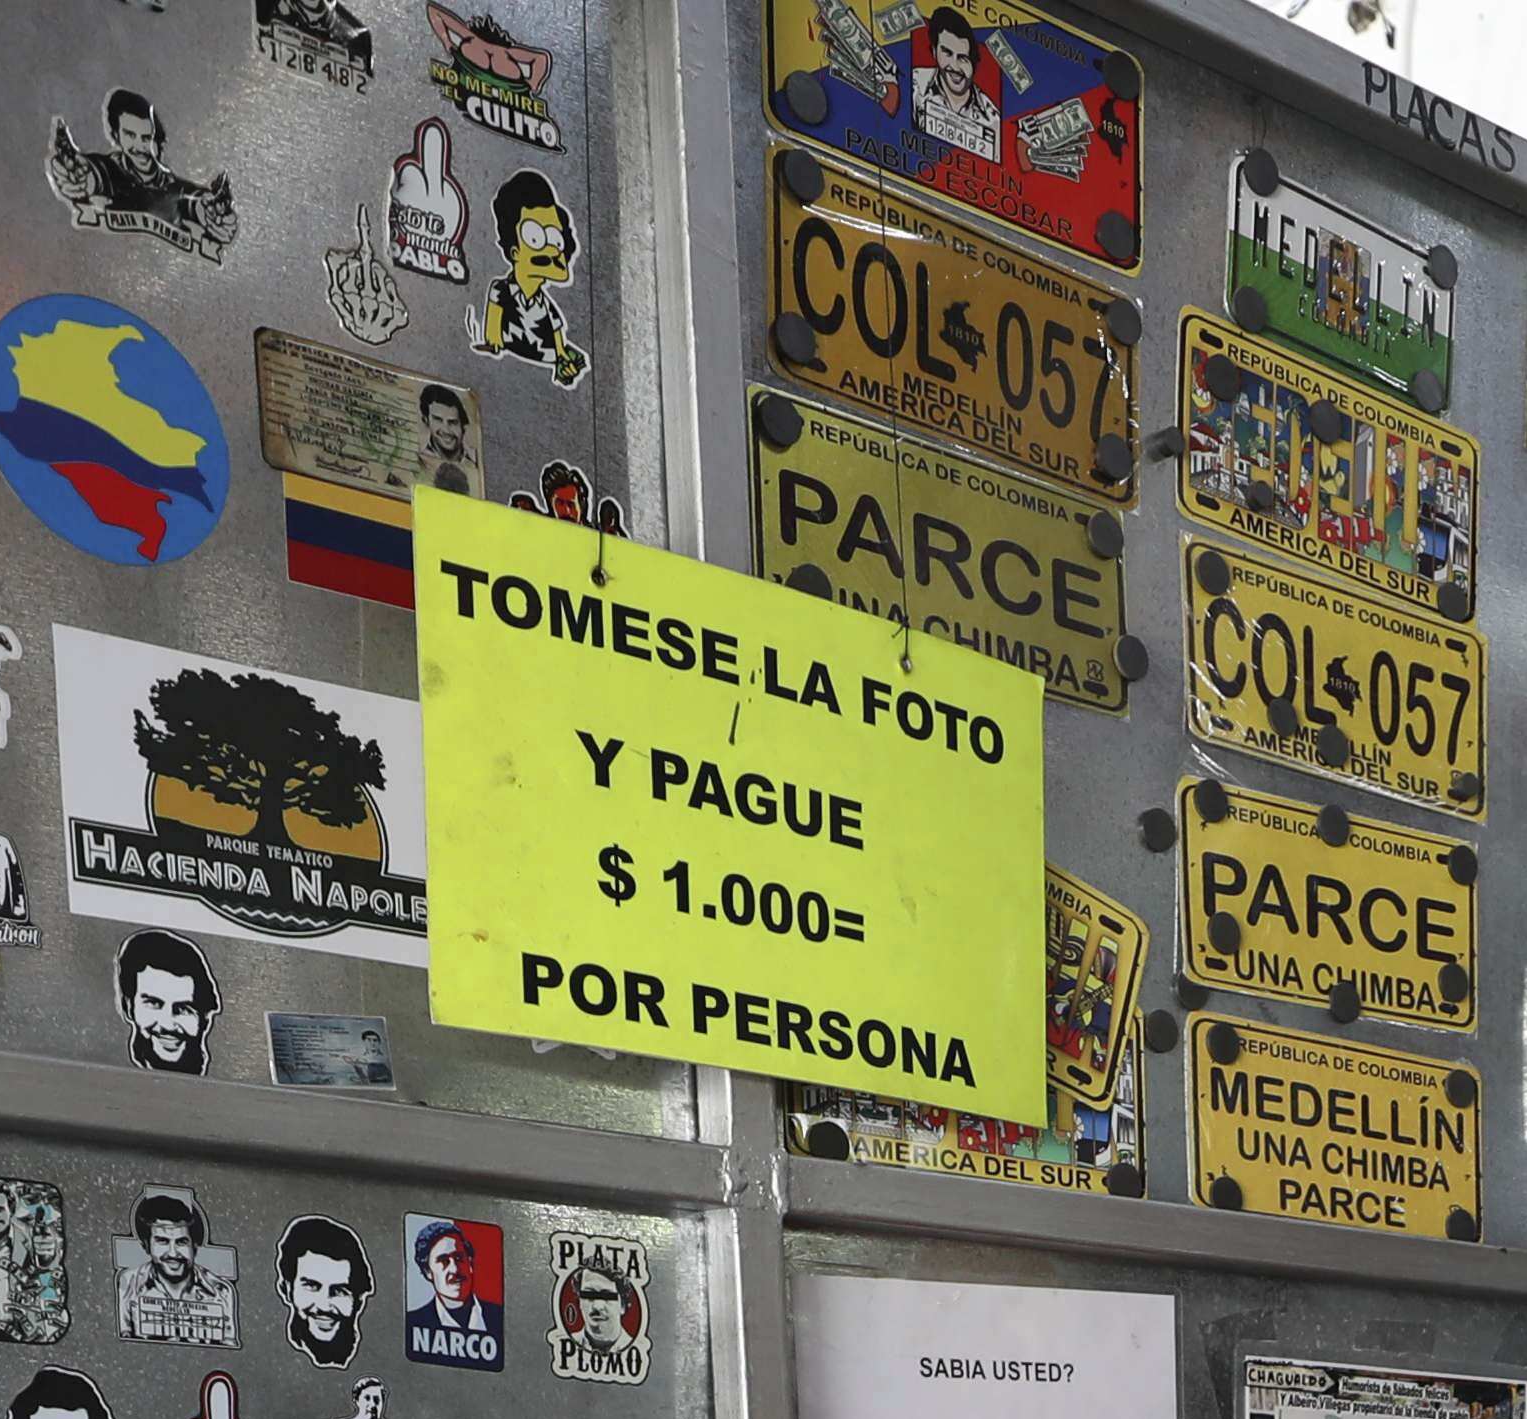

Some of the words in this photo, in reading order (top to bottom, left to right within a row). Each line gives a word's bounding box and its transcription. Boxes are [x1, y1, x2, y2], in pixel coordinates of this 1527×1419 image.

[431, 64, 459, 84] NO
[465, 75, 493, 98] ME
[498, 90, 544, 114] MIRE
[445, 86, 461, 101] EL
[465, 97, 557, 148] CULITO
[1101, 119, 1125, 140] 1810
[1362, 60, 1516, 173] PLACAS
[845, 128, 937, 184] PABLO
[946, 173, 1074, 241] ESCOBAR
[899, 130, 1023, 195] MEDELLÍN
[831, 184, 947, 248] REPÚBLICA
[952, 237, 978, 261] DE
[984, 244, 1083, 308] COLOMBIA
[792, 217, 957, 383] COL
[996, 301, 1119, 443] 057
[839, 369, 966, 434] AMERICA
[973, 422, 1022, 458] DEL
[1030, 442, 1080, 479] SUR
[903, 372, 1022, 436] MEDELLÍN
[1228, 343, 1324, 401] REPÚBLICA
[1328, 388, 1349, 410] DE
[1354, 400, 1437, 449] COLOMBIA
[810, 419, 931, 474] REPÚBLICA
[935, 464, 962, 487] DE
[967, 474, 1070, 523] COLOMBIA
[778, 468, 1106, 640] PARCE
[1230, 507, 1335, 565] AMERICA
[1339, 553, 1378, 584] DEL
[1387, 570, 1431, 603] SUR
[439, 560, 740, 688] TOMESE
[764, 646, 842, 717] LA
[862, 677, 1005, 765] FOTO
[1204, 597, 1338, 727] COL
[1370, 650, 1471, 765] 057
[575, 730, 625, 789] Y
[650, 749, 865, 851] PAGUE
[597, 844, 637, 909] $
[662, 858, 867, 944] 1.000=
[1200, 850, 1458, 966] PARCE
[1231, 948, 1304, 992] UNA
[521, 952, 670, 1028] POR
[692, 983, 977, 1089] PERSONA
[1209, 1066, 1466, 1155] MEDELLÍN
[1333, 1055, 1355, 1075] DE
[1357, 1061, 1438, 1090] COLOMBIA
[1236, 1125, 1314, 1172] UNA
[1321, 1142, 1450, 1193] CHIMBA
[1278, 1179, 1407, 1230] PARCE
[411, 1326, 498, 1361] NARCO
[920, 1357, 987, 1380] SABIA
[992, 1361, 1074, 1382] USTED?
